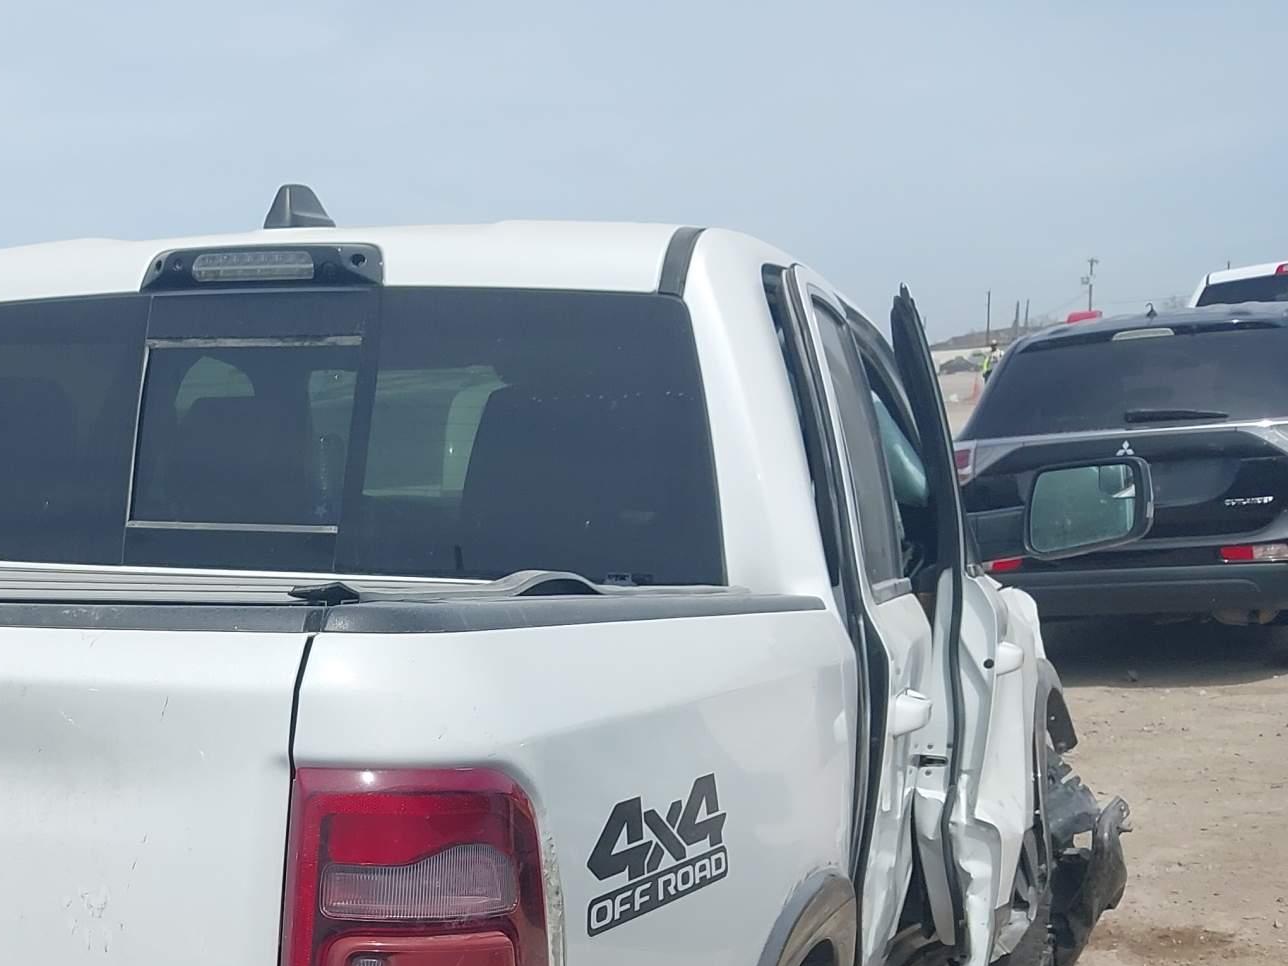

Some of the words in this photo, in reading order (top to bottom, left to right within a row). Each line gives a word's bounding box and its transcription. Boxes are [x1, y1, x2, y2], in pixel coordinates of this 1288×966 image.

[587, 772, 727, 882] 4x4
[590, 881, 652, 930] OFF
[658, 851, 726, 901] ROAD
